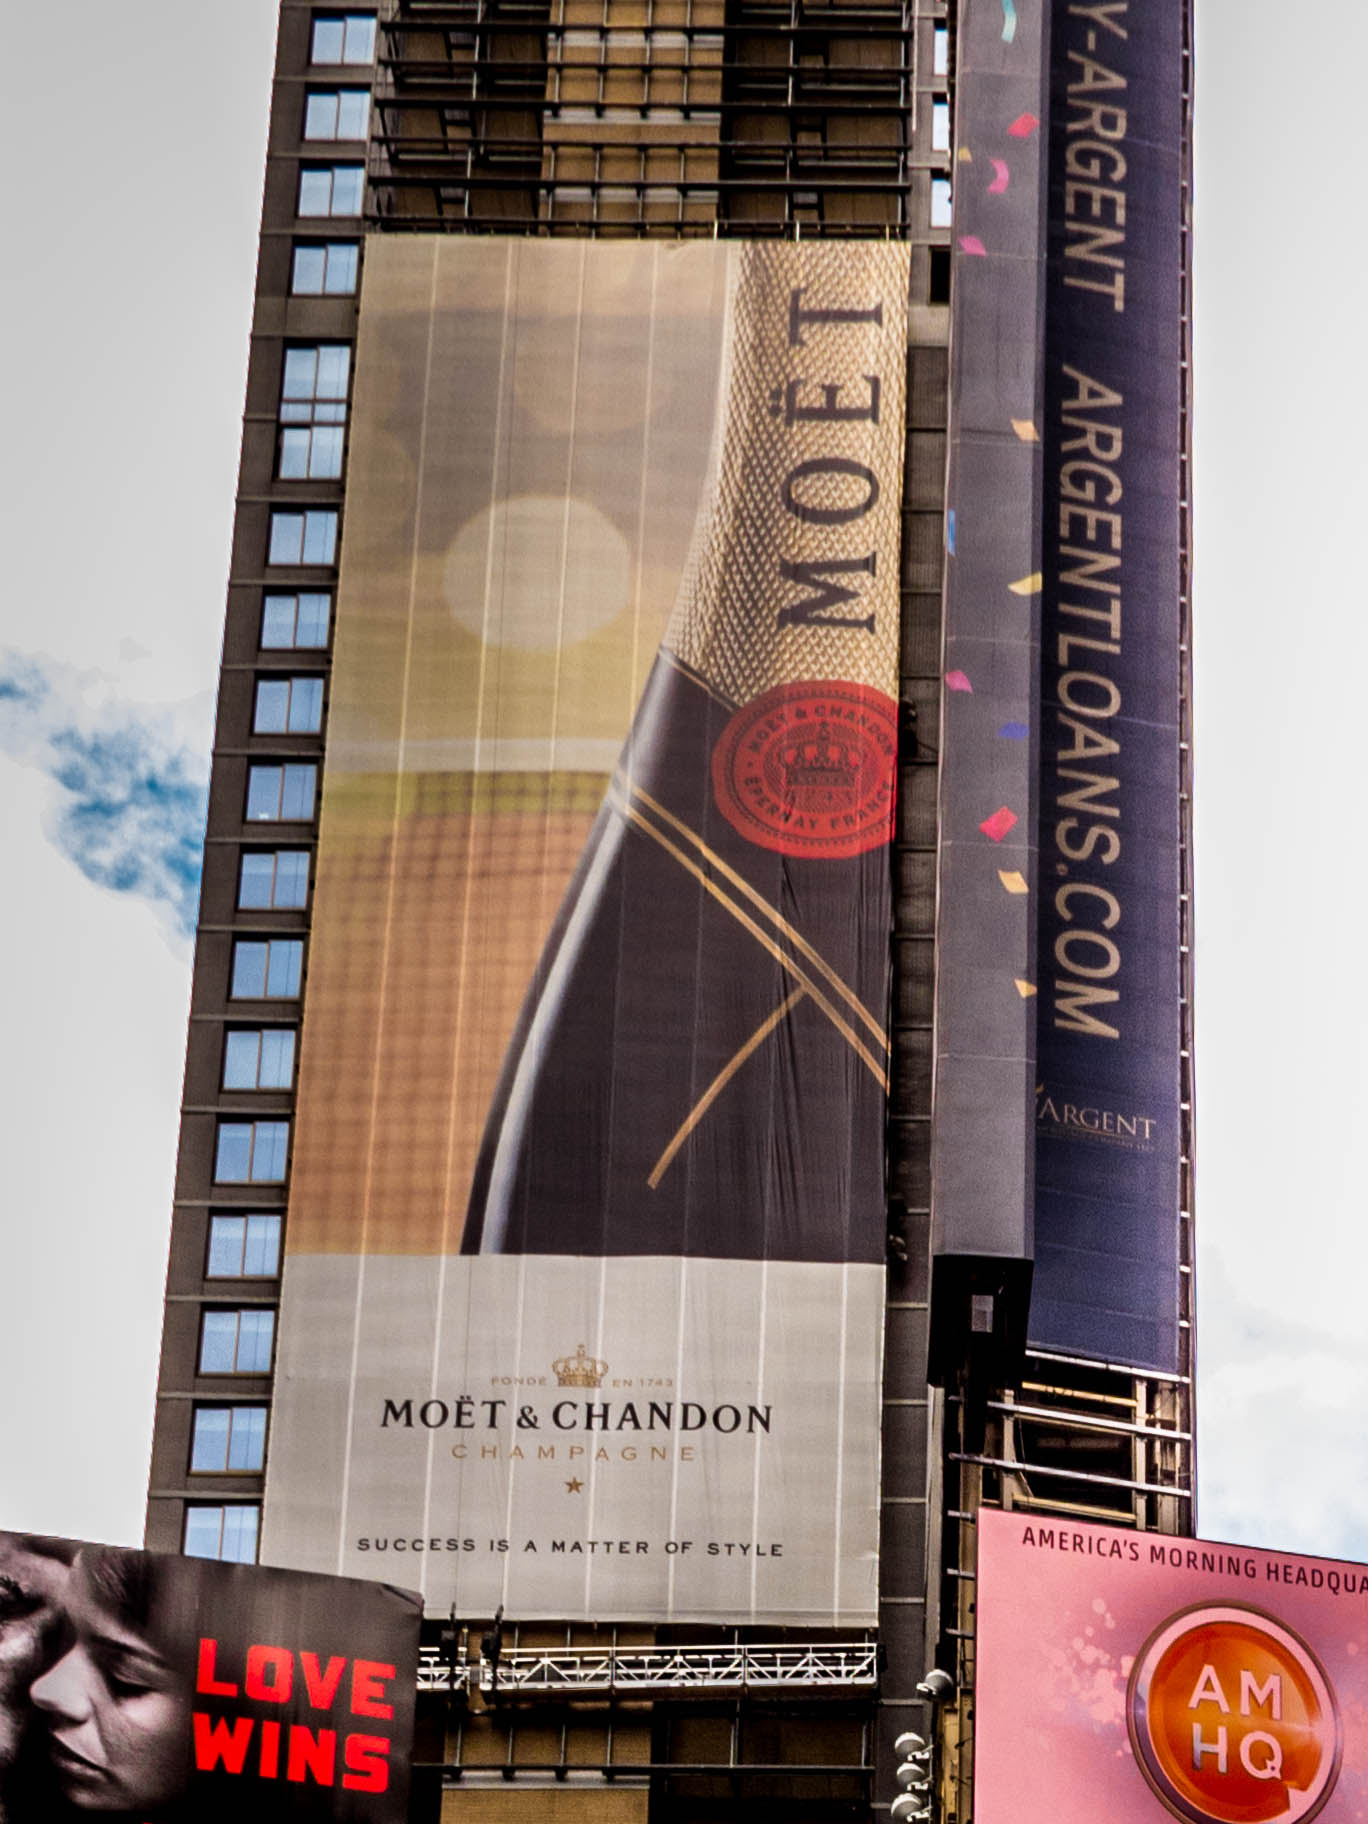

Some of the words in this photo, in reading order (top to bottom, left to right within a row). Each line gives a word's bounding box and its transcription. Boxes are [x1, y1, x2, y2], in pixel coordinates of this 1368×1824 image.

[769, 287, 884, 632] MOËT
[1054, 364, 1124, 1040] ARGENTLOANS.COM
[1038, 1097, 1157, 1140] ARGENT
[380, 1395, 507, 1431] MOËT
[516, 1404, 539, 1430] &
[551, 1400, 772, 1434] CHANDON
[451, 1444, 697, 1463] CHAMPAGNE
[357, 1538, 476, 1553] SUCCESS
[489, 1539, 509, 1553] IS
[524, 1541, 538, 1554] A
[551, 1540, 649, 1555] MATTER
[664, 1541, 693, 1555] OF
[707, 1542, 784, 1558] STYLE
[1022, 1526, 1140, 1562] AMERICA'S
[1150, 1545, 1258, 1580] MORNING
[195, 1638, 397, 1720] LOVE
[1187, 1664, 1283, 1720] AM
[192, 1711, 392, 1794] WINS
[1191, 1722, 1284, 1781] HQ
